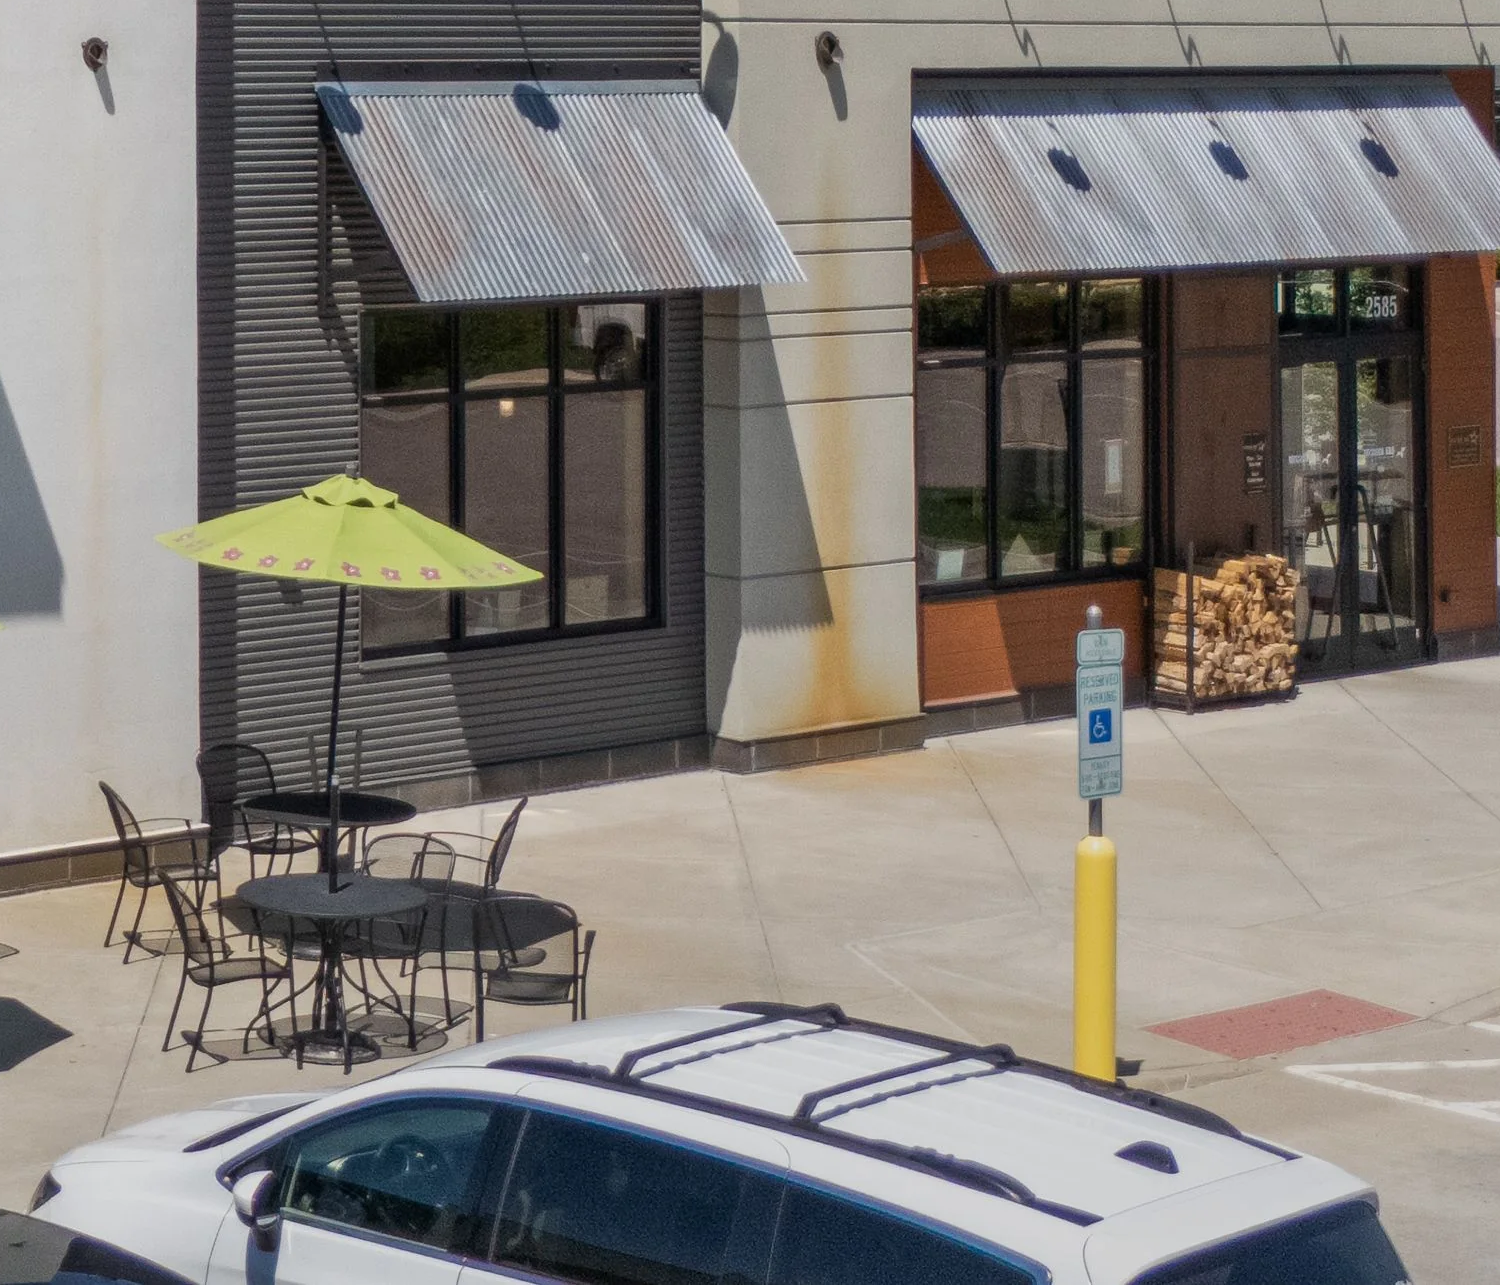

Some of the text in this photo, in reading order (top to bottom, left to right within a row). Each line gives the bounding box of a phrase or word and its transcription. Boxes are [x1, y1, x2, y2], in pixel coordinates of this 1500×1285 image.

[1365, 295, 1398, 319] 2585
[1080, 673, 1119, 688] RESERVED
[1083, 690, 1117, 705] PARKING
